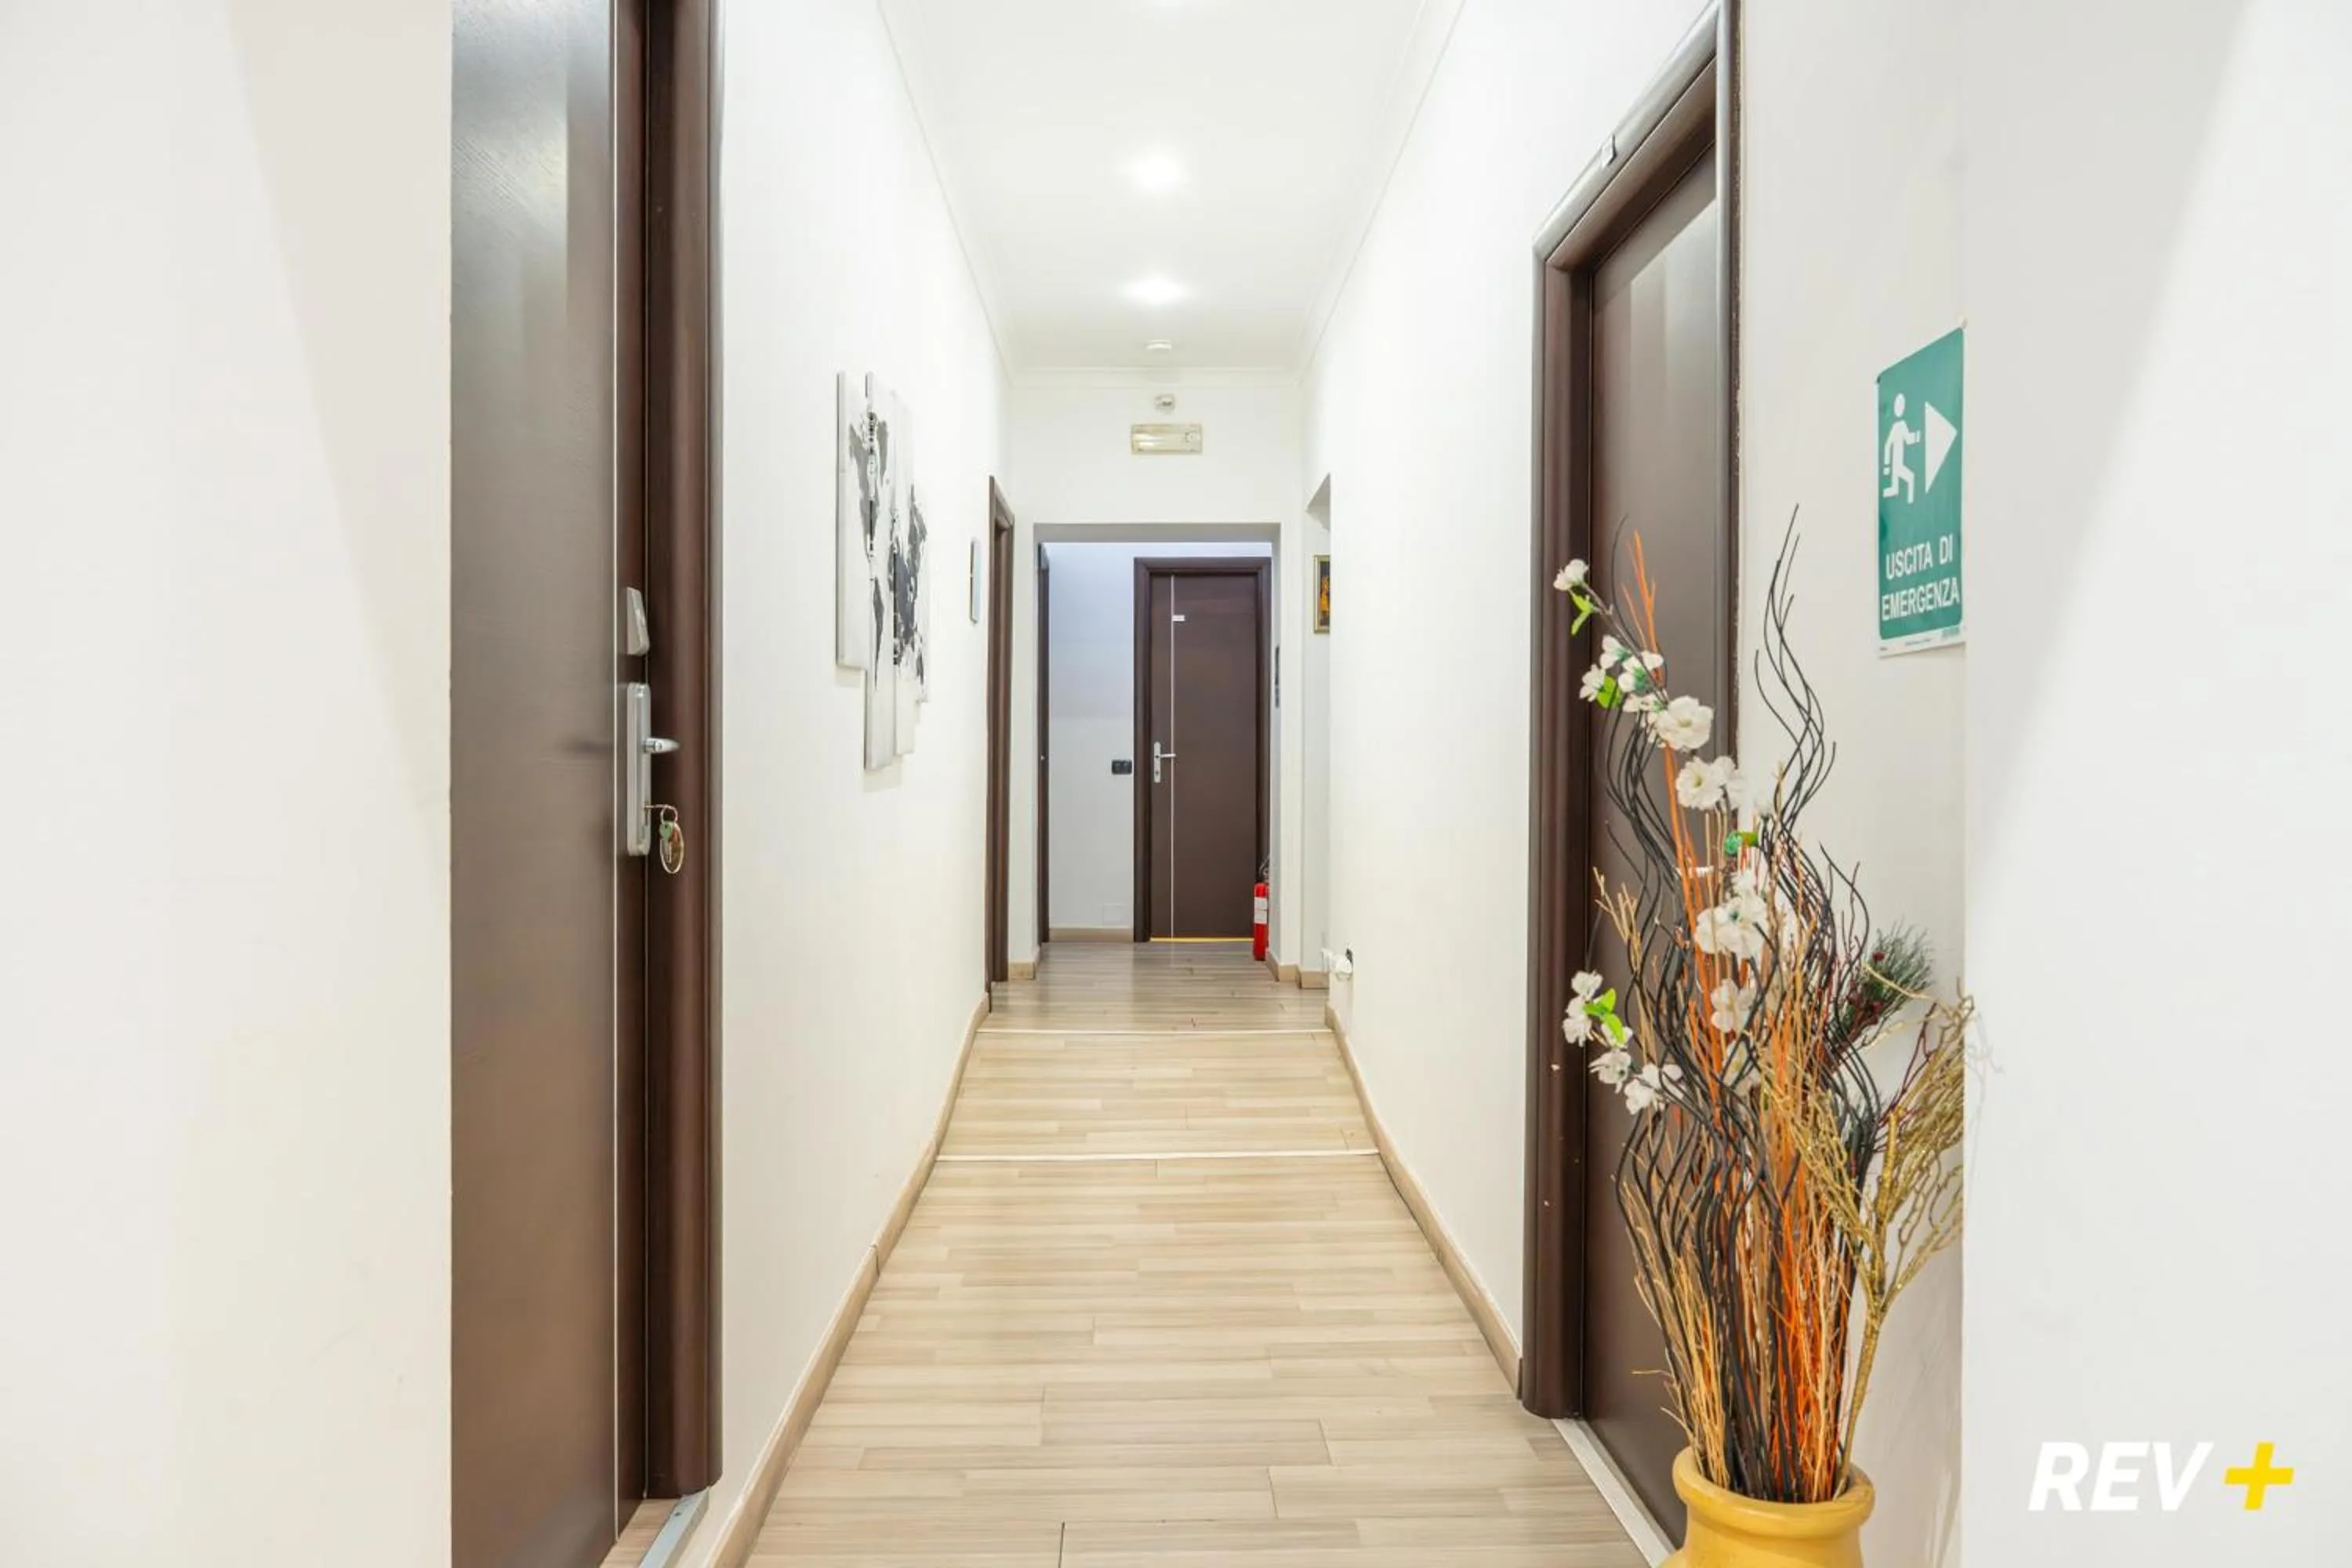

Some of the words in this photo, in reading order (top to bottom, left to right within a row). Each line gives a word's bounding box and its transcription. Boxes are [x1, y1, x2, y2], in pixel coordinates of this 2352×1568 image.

[1886, 541, 1933, 580] USCITA
[1939, 534, 1953, 565] DI
[1882, 577, 1960, 622] EMERGENZA
